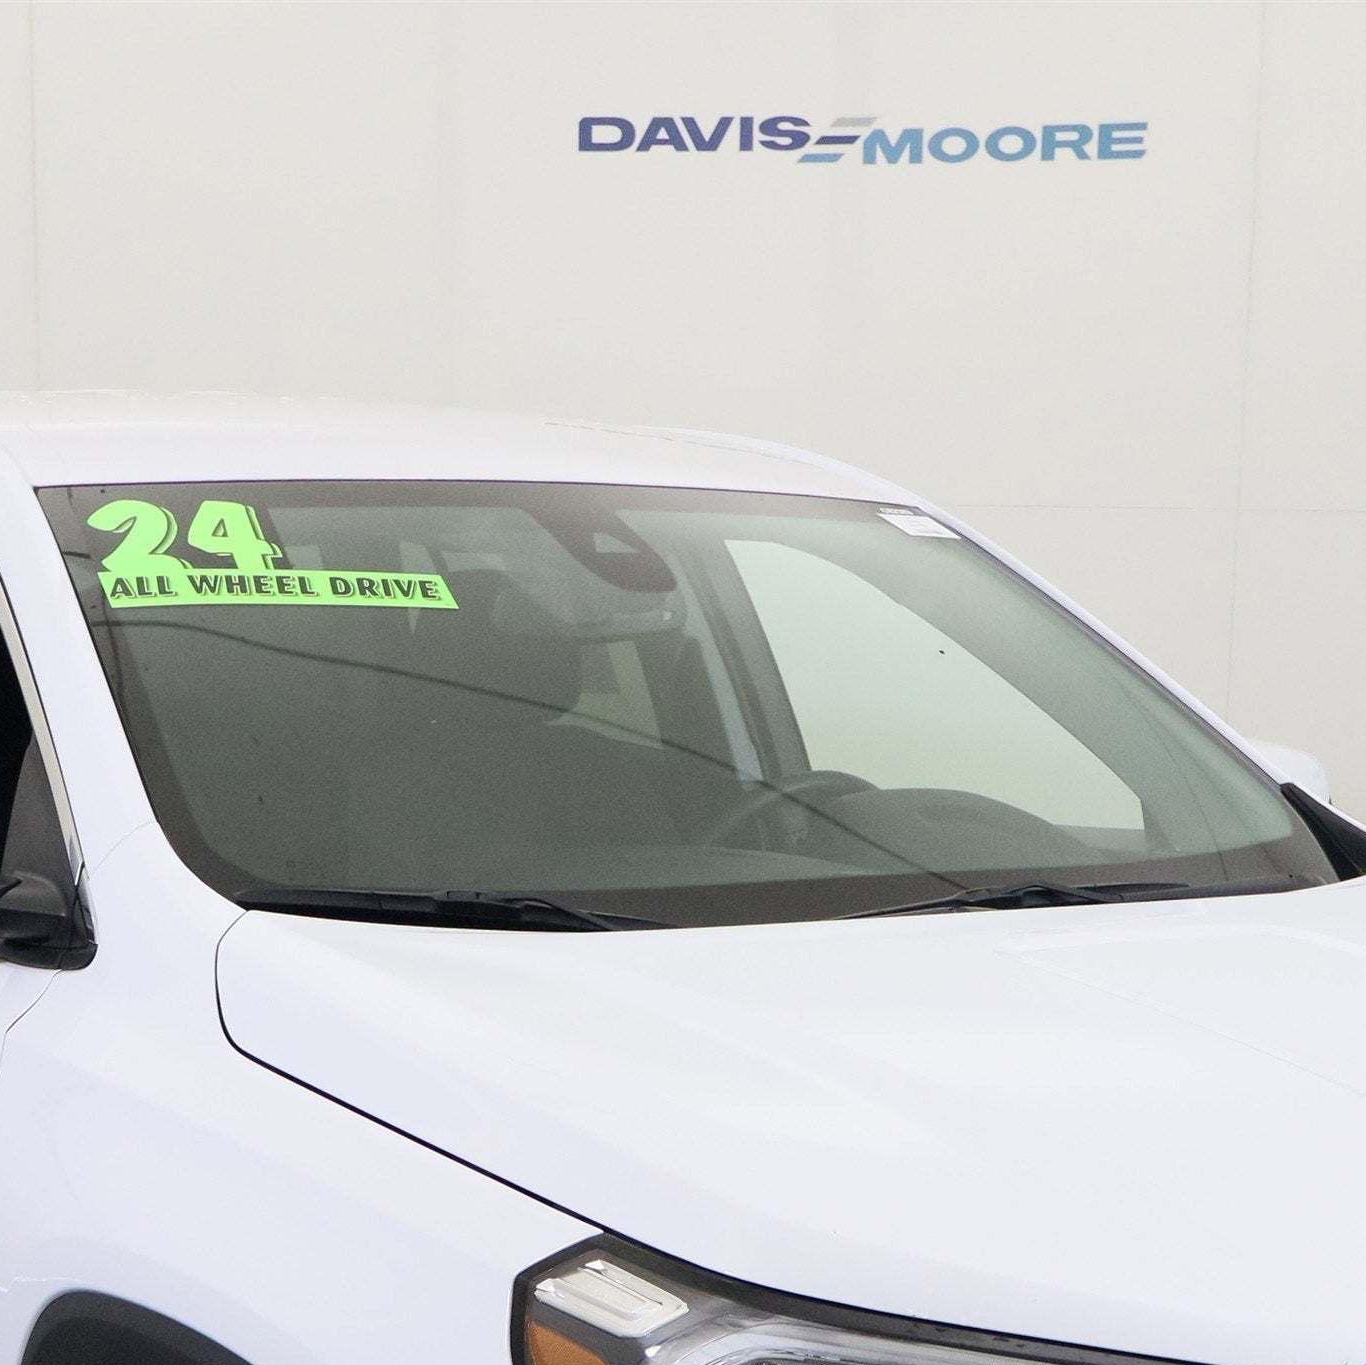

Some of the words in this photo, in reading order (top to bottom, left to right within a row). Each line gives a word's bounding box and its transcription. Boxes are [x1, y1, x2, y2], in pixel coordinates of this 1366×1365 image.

[578, 115, 811, 153] DAVIS
[862, 121, 1149, 165] MOORE
[86, 499, 284, 572] 24
[109, 575, 177, 599] ALL
[187, 574, 318, 597] WHEEL
[328, 576, 441, 601] DRIVE
